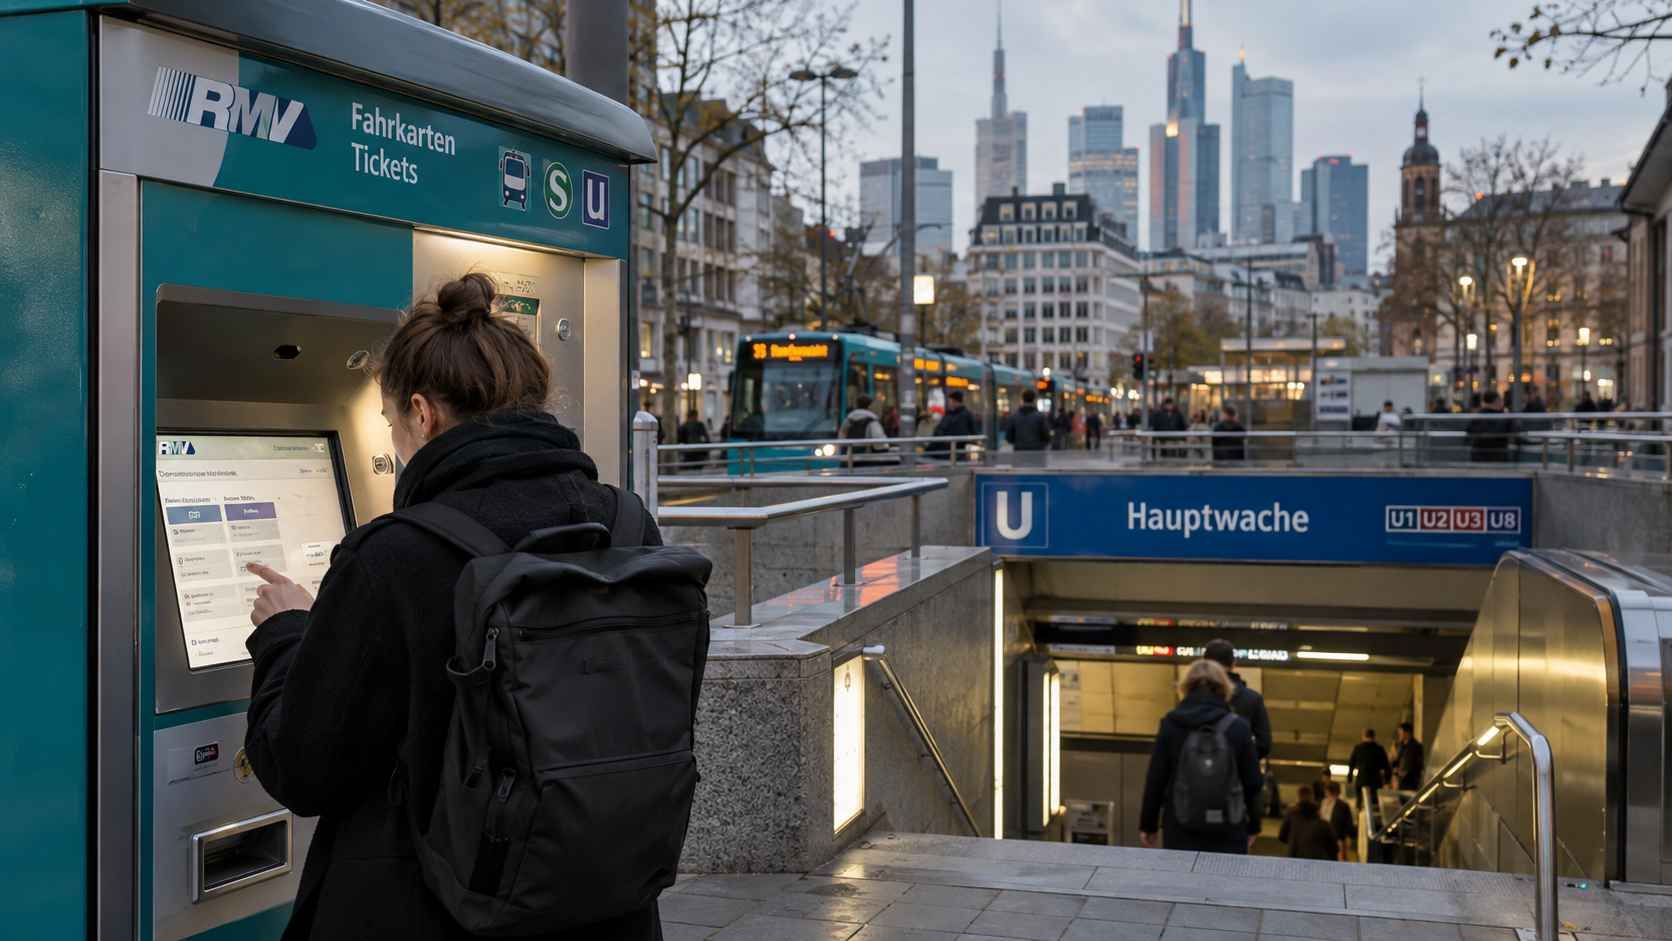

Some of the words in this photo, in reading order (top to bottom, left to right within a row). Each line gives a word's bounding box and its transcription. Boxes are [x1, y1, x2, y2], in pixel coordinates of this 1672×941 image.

[186, 76, 305, 144] RMV
[352, 101, 456, 156] Fahrkarten
[351, 142, 419, 185] Tickets
[548, 169, 568, 212] S
[996, 491, 1034, 540] U
[1126, 501, 1310, 539] Hauptwache
[1390, 510, 1415, 528] U1
[1423, 511, 1449, 529] U2
[1456, 511, 1482, 529] U3
[1490, 512, 1516, 529] U8
